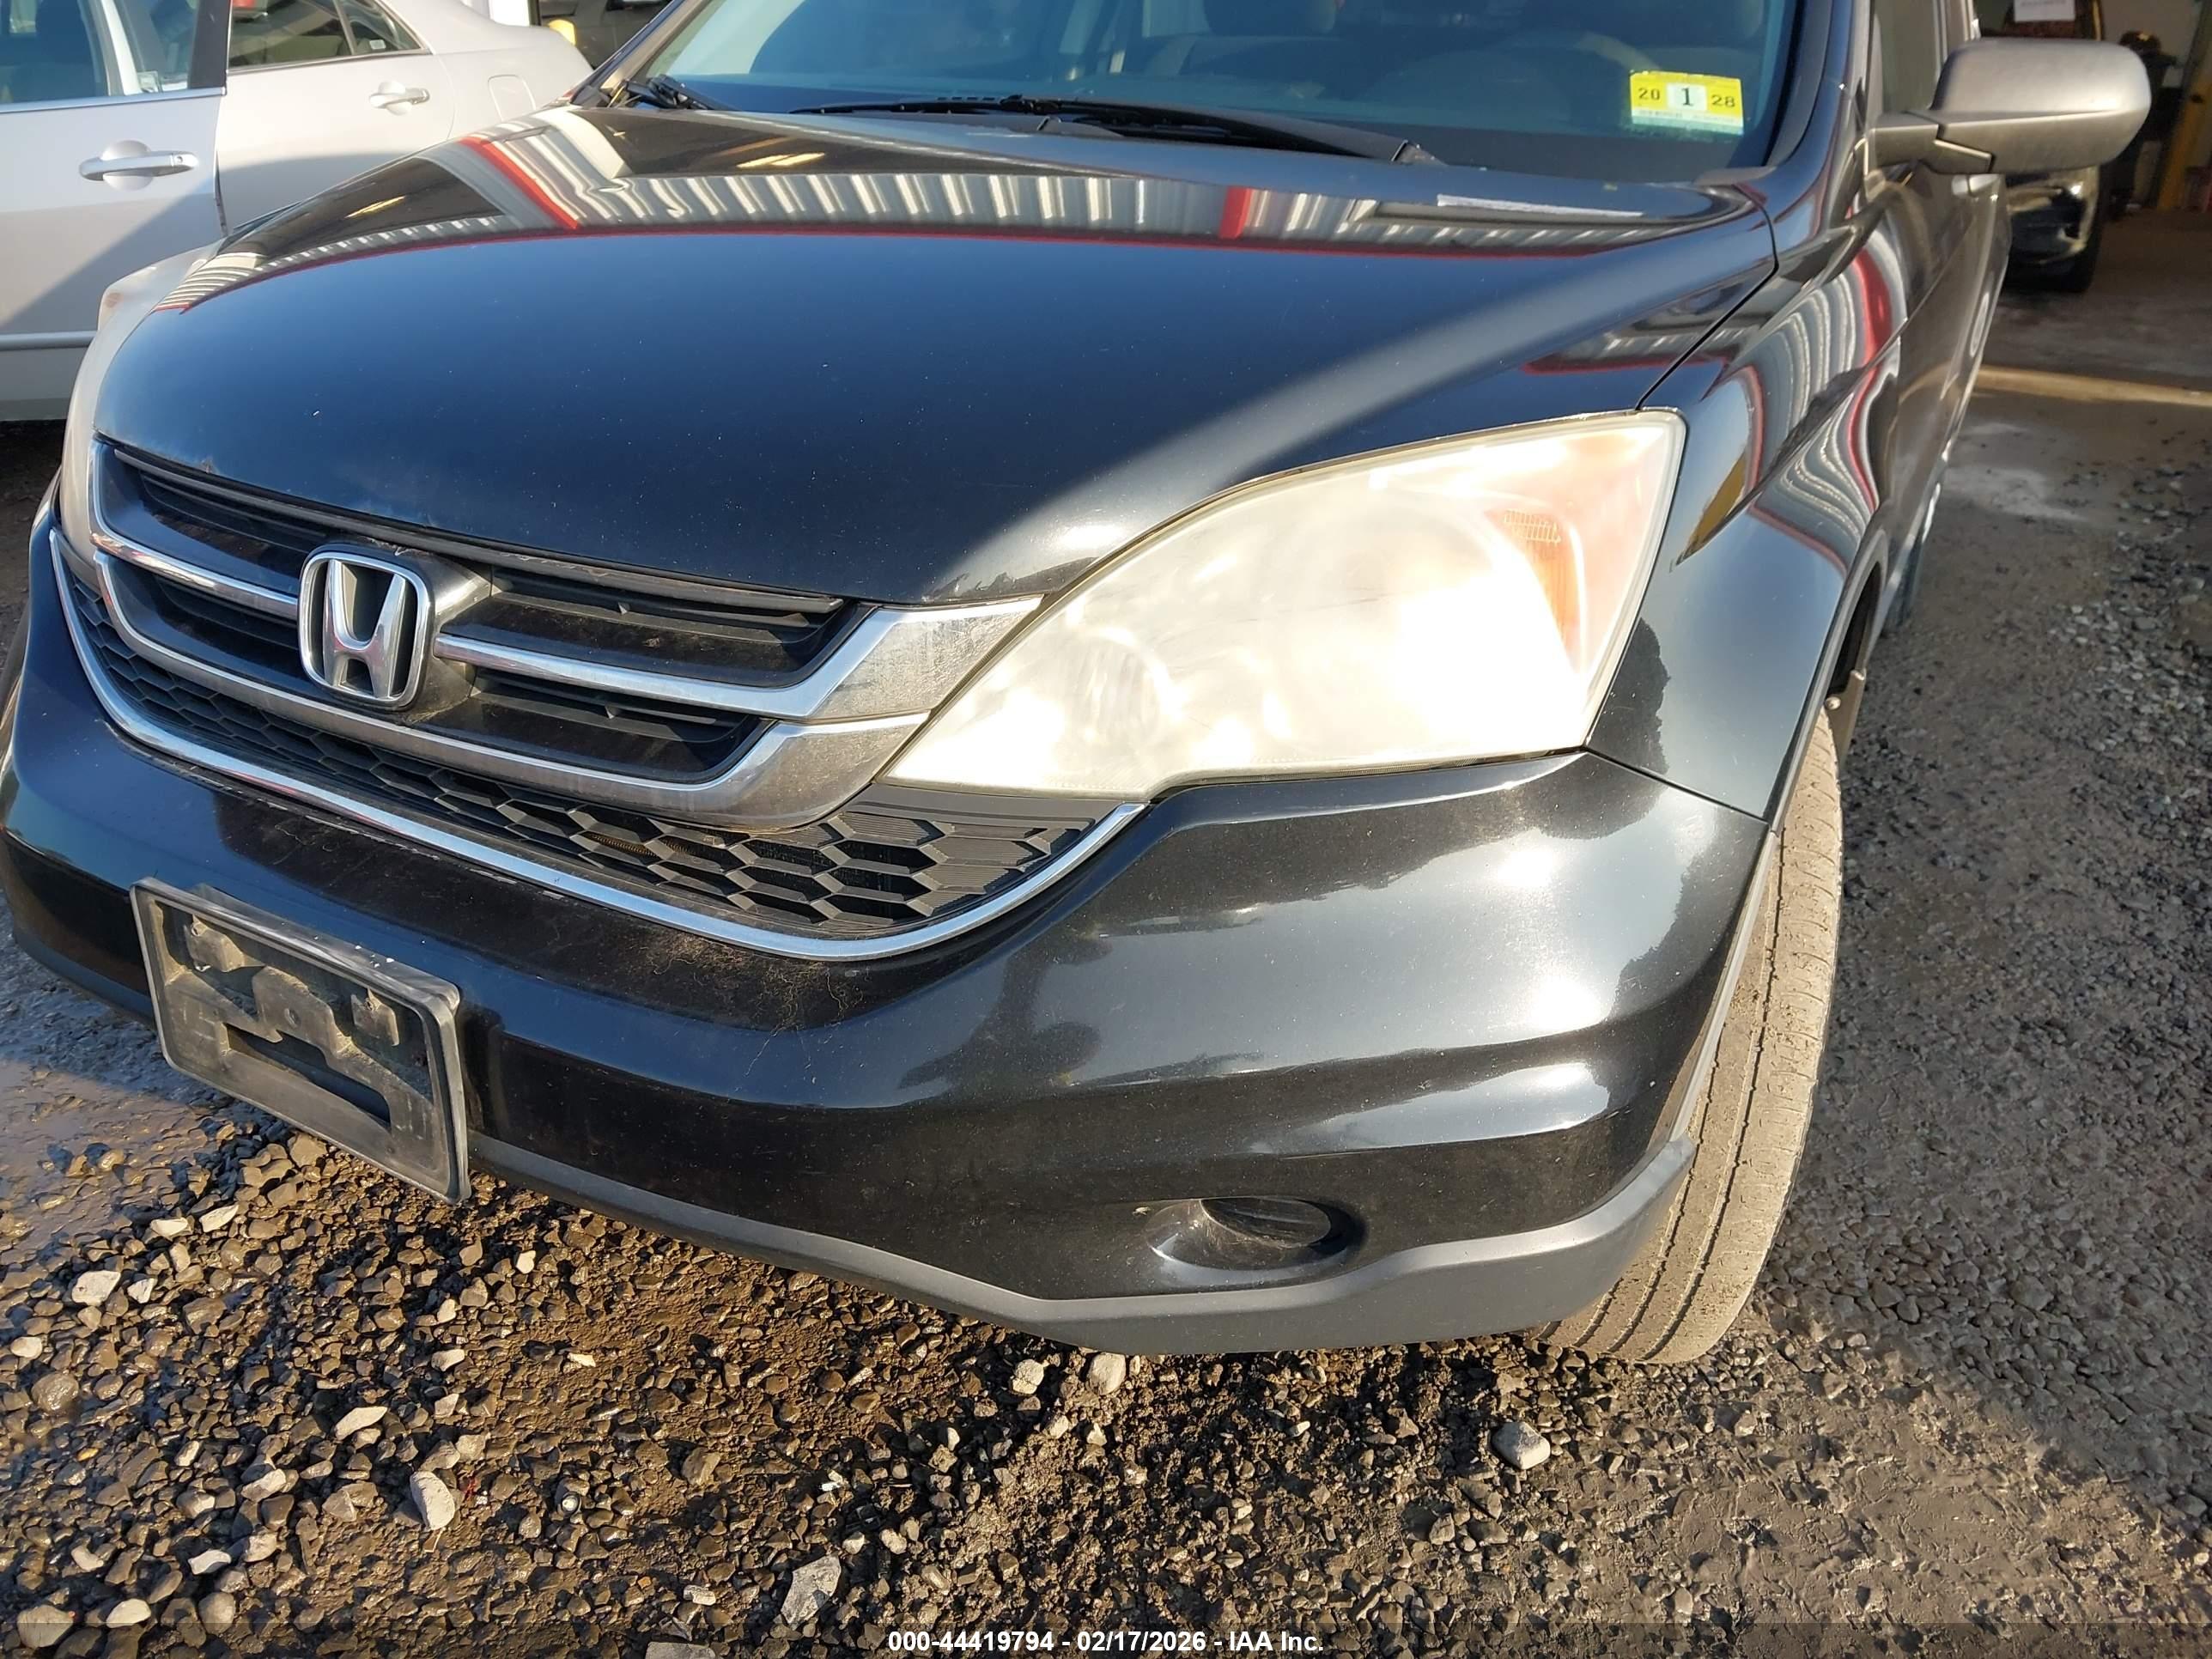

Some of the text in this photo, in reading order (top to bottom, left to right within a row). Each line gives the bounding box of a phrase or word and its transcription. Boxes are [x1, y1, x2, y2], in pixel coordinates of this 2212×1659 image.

[1638, 87, 1735, 107] 20 1 28
